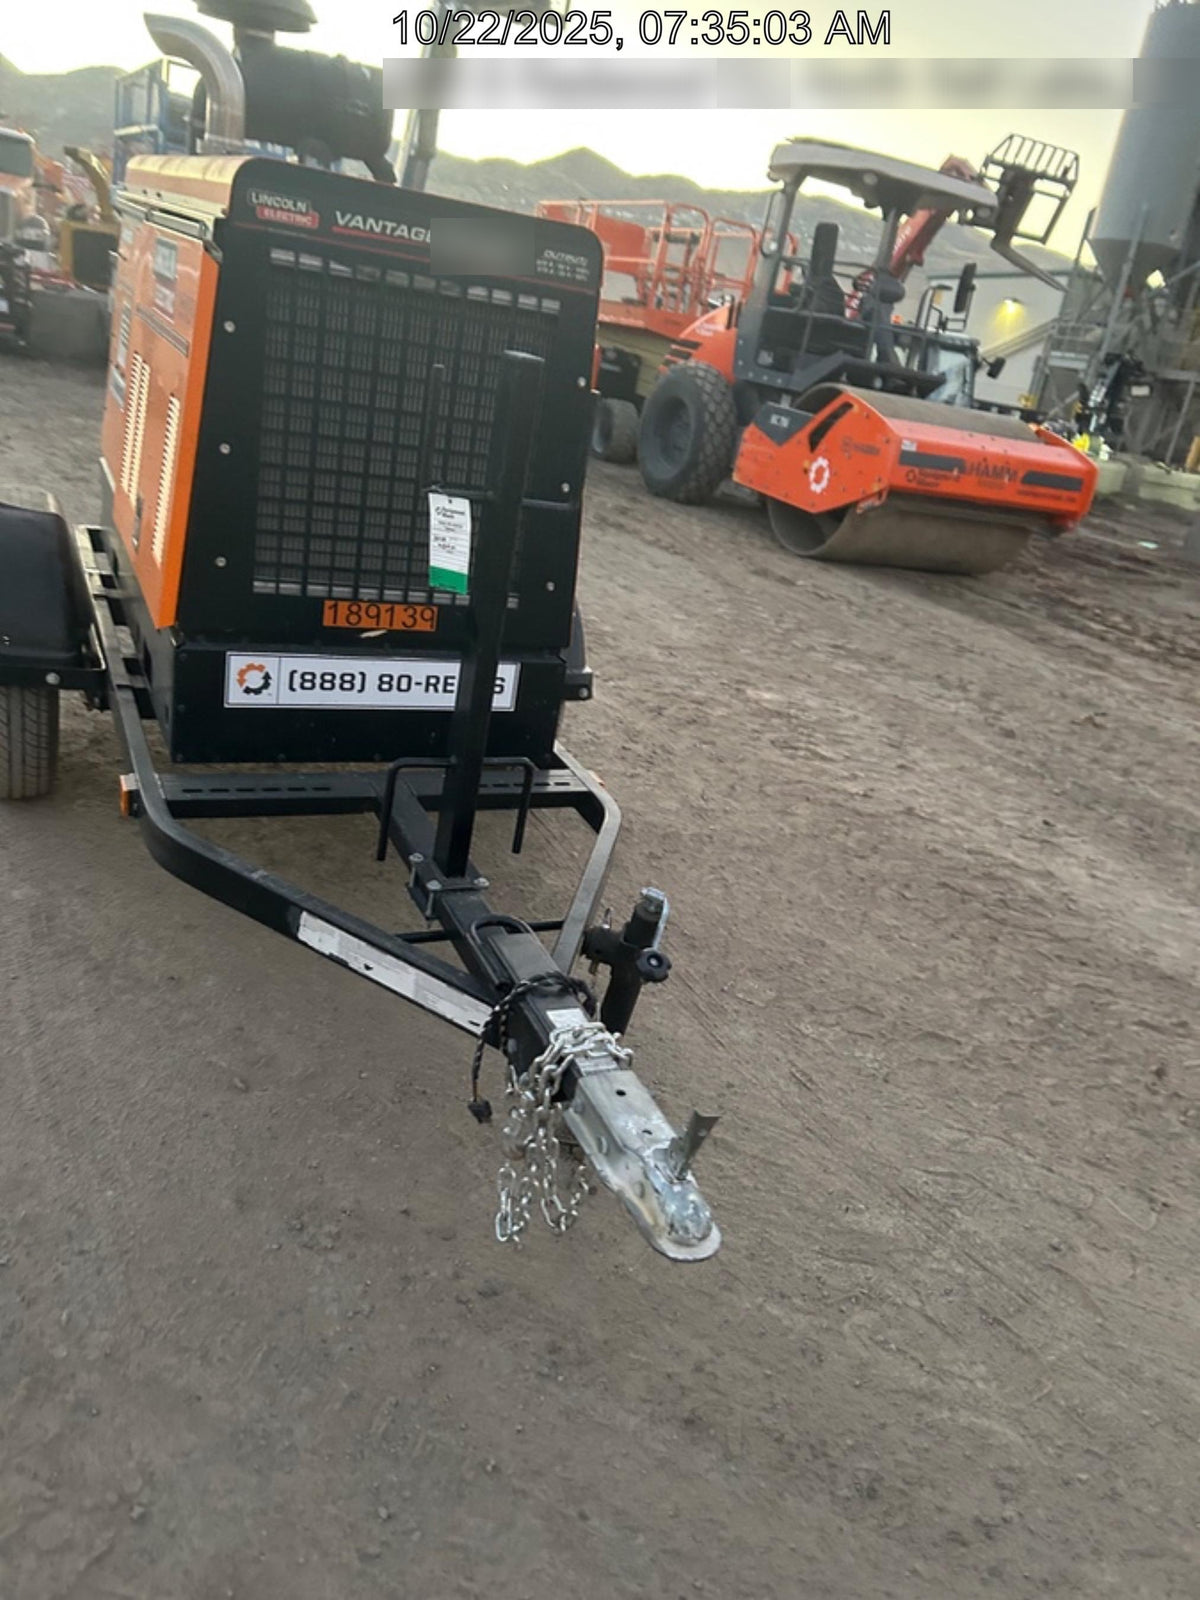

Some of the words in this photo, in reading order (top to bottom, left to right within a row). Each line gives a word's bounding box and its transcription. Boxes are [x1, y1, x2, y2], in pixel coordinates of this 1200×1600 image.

[251, 191, 307, 213] LINCOLN
[327, 602, 436, 630] 189139
[288, 669, 367, 692] (888)
[376, 672, 506, 695] 80-RES
